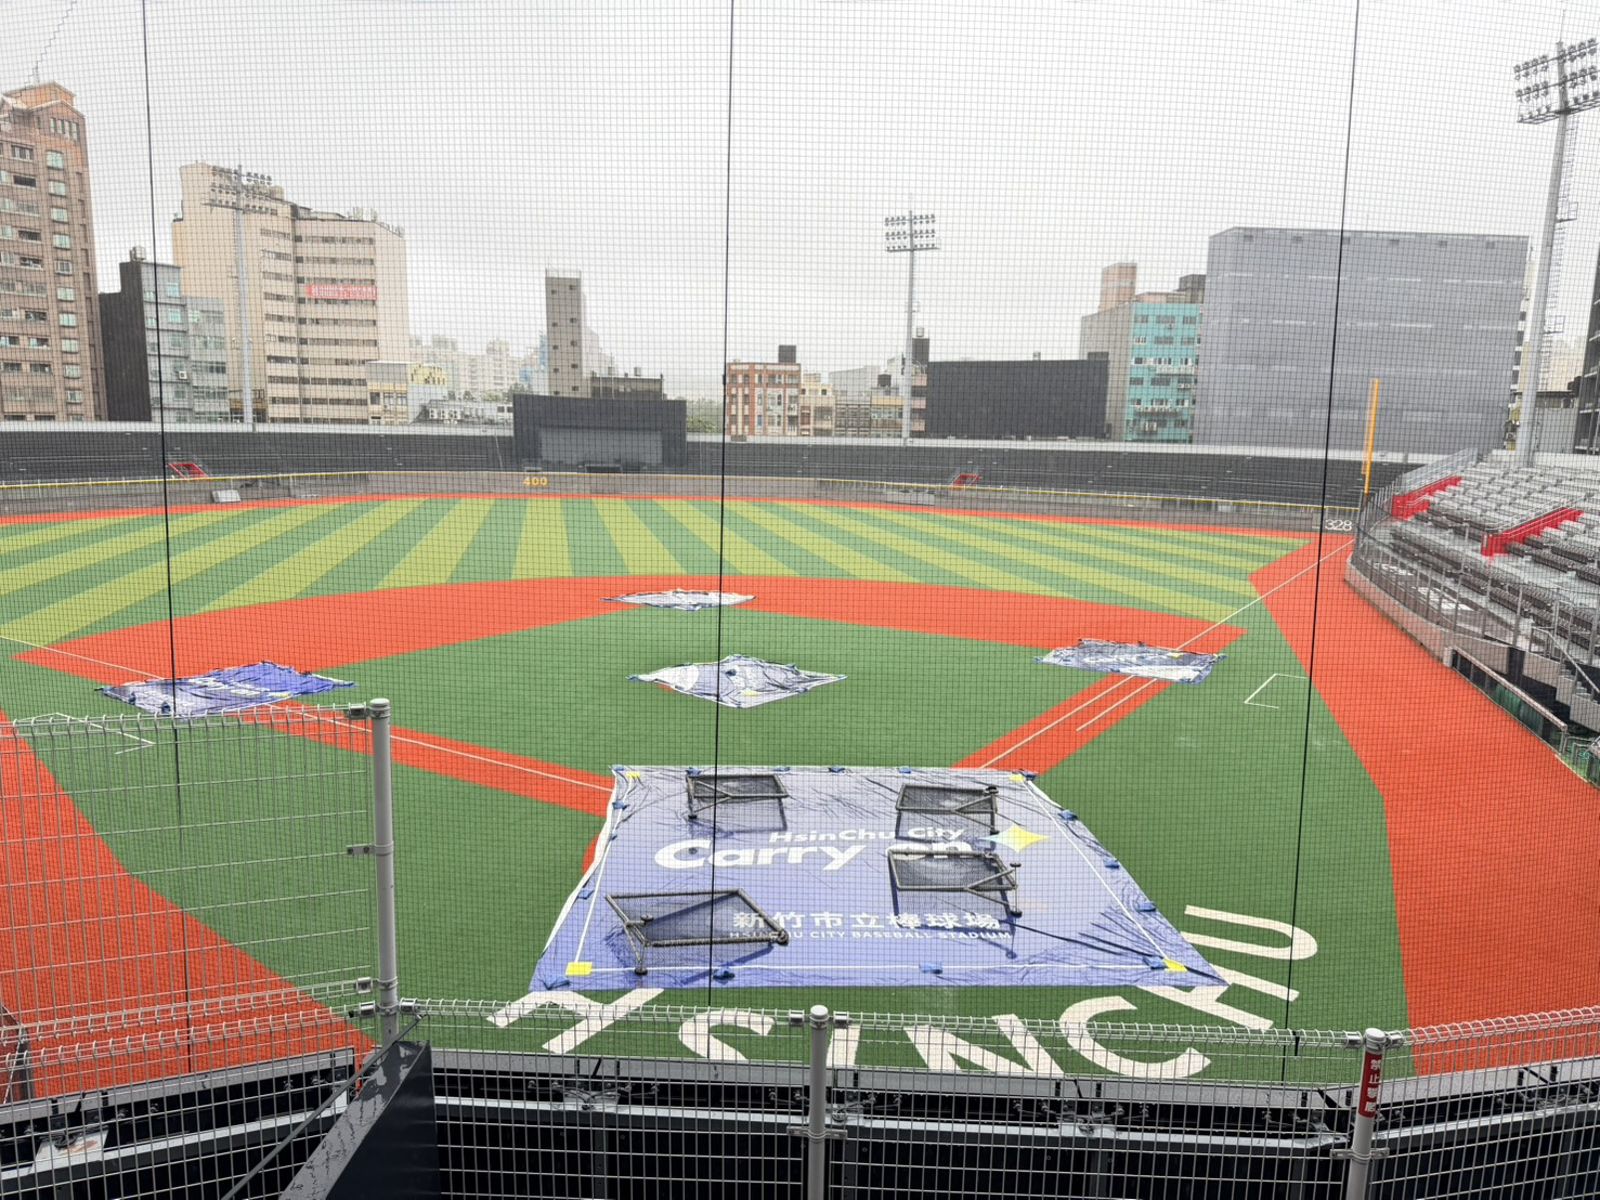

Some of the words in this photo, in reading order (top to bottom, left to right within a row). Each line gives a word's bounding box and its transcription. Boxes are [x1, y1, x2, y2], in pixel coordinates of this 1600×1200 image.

[523, 477, 548, 486] 400
[1325, 519, 1352, 531] 328
[769, 829, 895, 843] HsinChu
[908, 827, 964, 840] City
[654, 838, 862, 871] Carry
[810, 931, 845, 939] CITY
[852, 931, 932, 939] BASEBALL
[939, 931, 1012, 939] STADIUM
